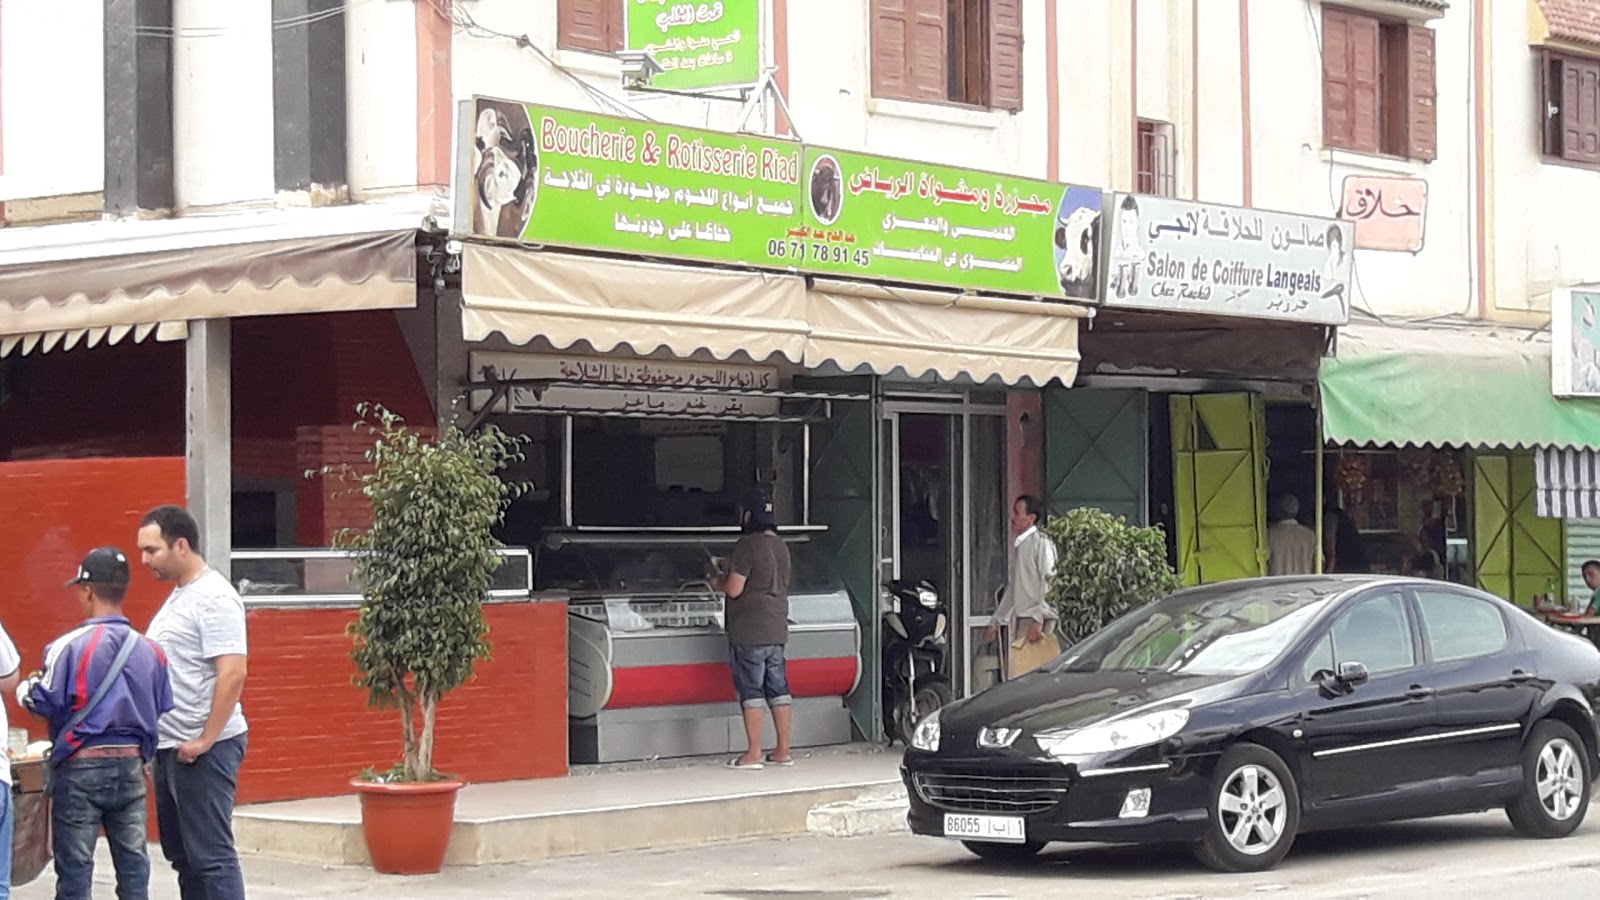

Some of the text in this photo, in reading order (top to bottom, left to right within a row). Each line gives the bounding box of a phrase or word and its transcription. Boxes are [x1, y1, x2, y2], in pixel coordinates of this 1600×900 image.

[542, 117, 798, 184] Boucherie & Rotisserie Riad
[615, 175, 670, 204] موجودة
[674, 187, 719, 207] اللحوم
[848, 166, 915, 200] الرياض
[1202, 208, 1262, 241] للحلاقة
[1271, 223, 1324, 251] صالون
[768, 239, 869, 266] 06 71 78 91 45
[1147, 251, 1321, 296] Salon de Coiffure Langeais
